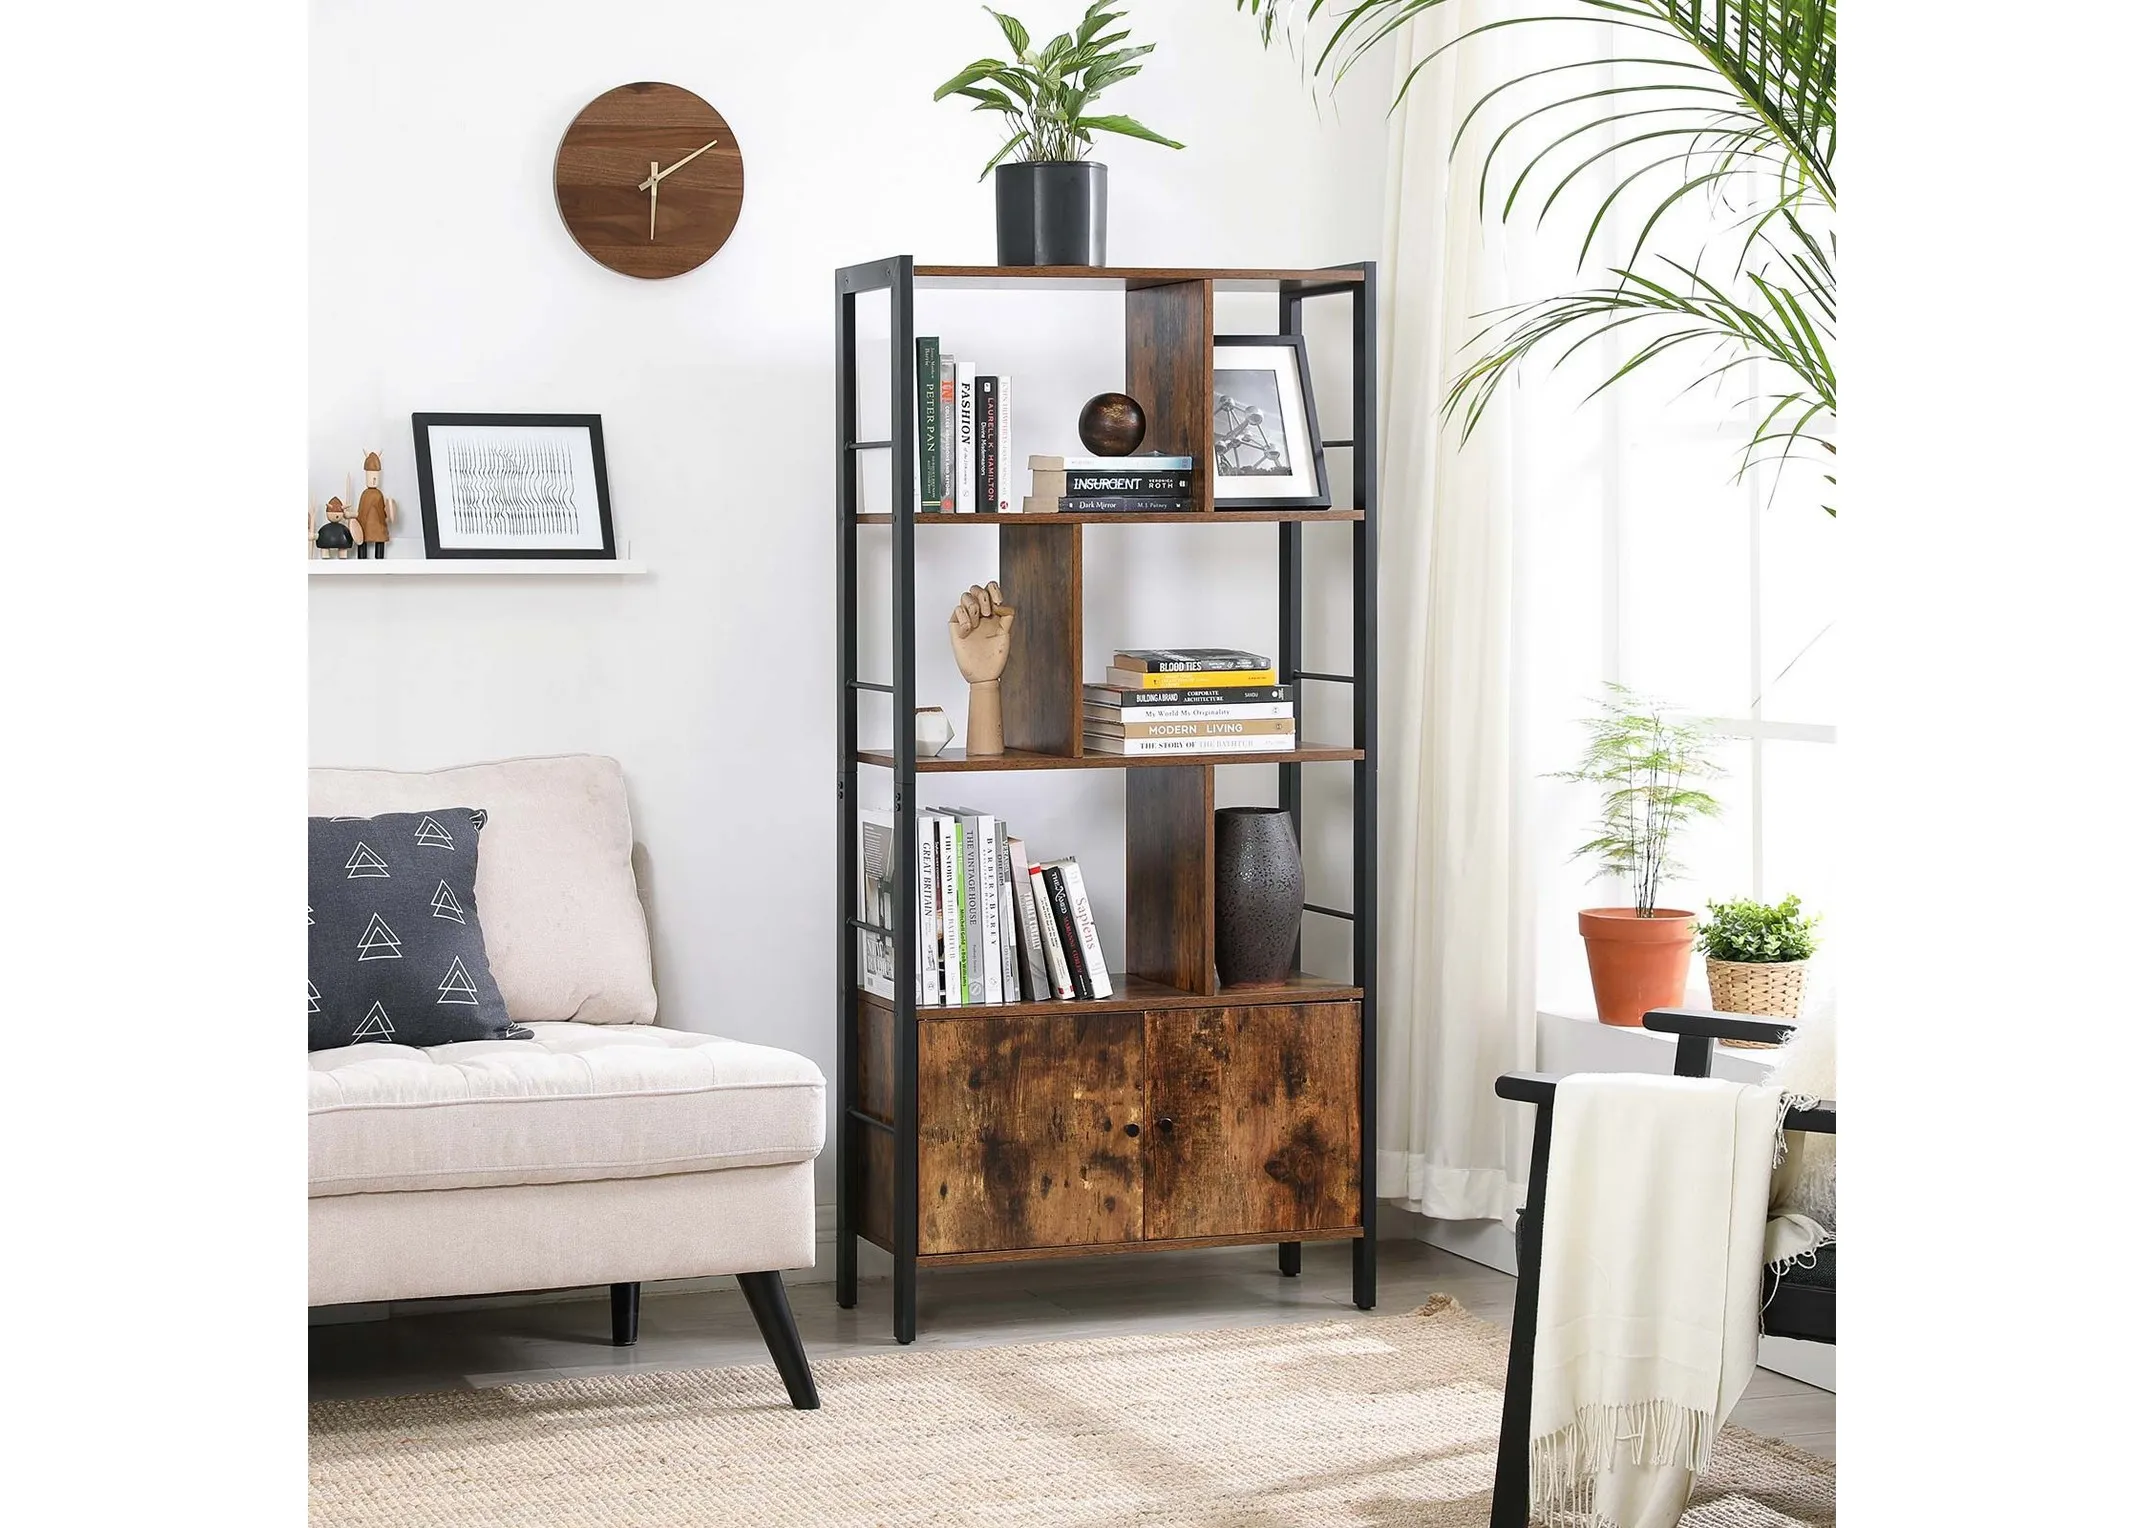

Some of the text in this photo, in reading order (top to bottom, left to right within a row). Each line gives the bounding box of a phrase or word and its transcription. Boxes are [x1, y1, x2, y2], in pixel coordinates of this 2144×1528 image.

[926, 383, 935, 423] PETER
[961, 382, 971, 444] FASHION
[987, 397, 995, 439] LAURELL
[926, 426, 936, 452] PAN
[987, 455, 995, 501] HAMILTON
[1073, 478, 1143, 490] INSURGENT
[1079, 501, 1095, 509] Dark
[1096, 501, 1117, 510] Mirror
[1159, 662, 1185, 672] BLOOD
[1185, 661, 1202, 671] TIES
[1145, 710, 1156, 718] My
[1157, 709, 1179, 718] World
[1192, 708, 1230, 718] Originality
[1149, 724, 1243, 735] MODERN LIVING
[1140, 742, 1157, 750] THE
[1158, 741, 1183, 749] STORY
[923, 842, 932, 874] GREAT
[947, 884, 954, 896] OF
[966, 830, 977, 925] THE VINTAGE HOUSE
[1051, 872, 1061, 889] THE
[924, 877, 933, 917] BRITAIN
[1075, 897, 1096, 951] Sapiens
